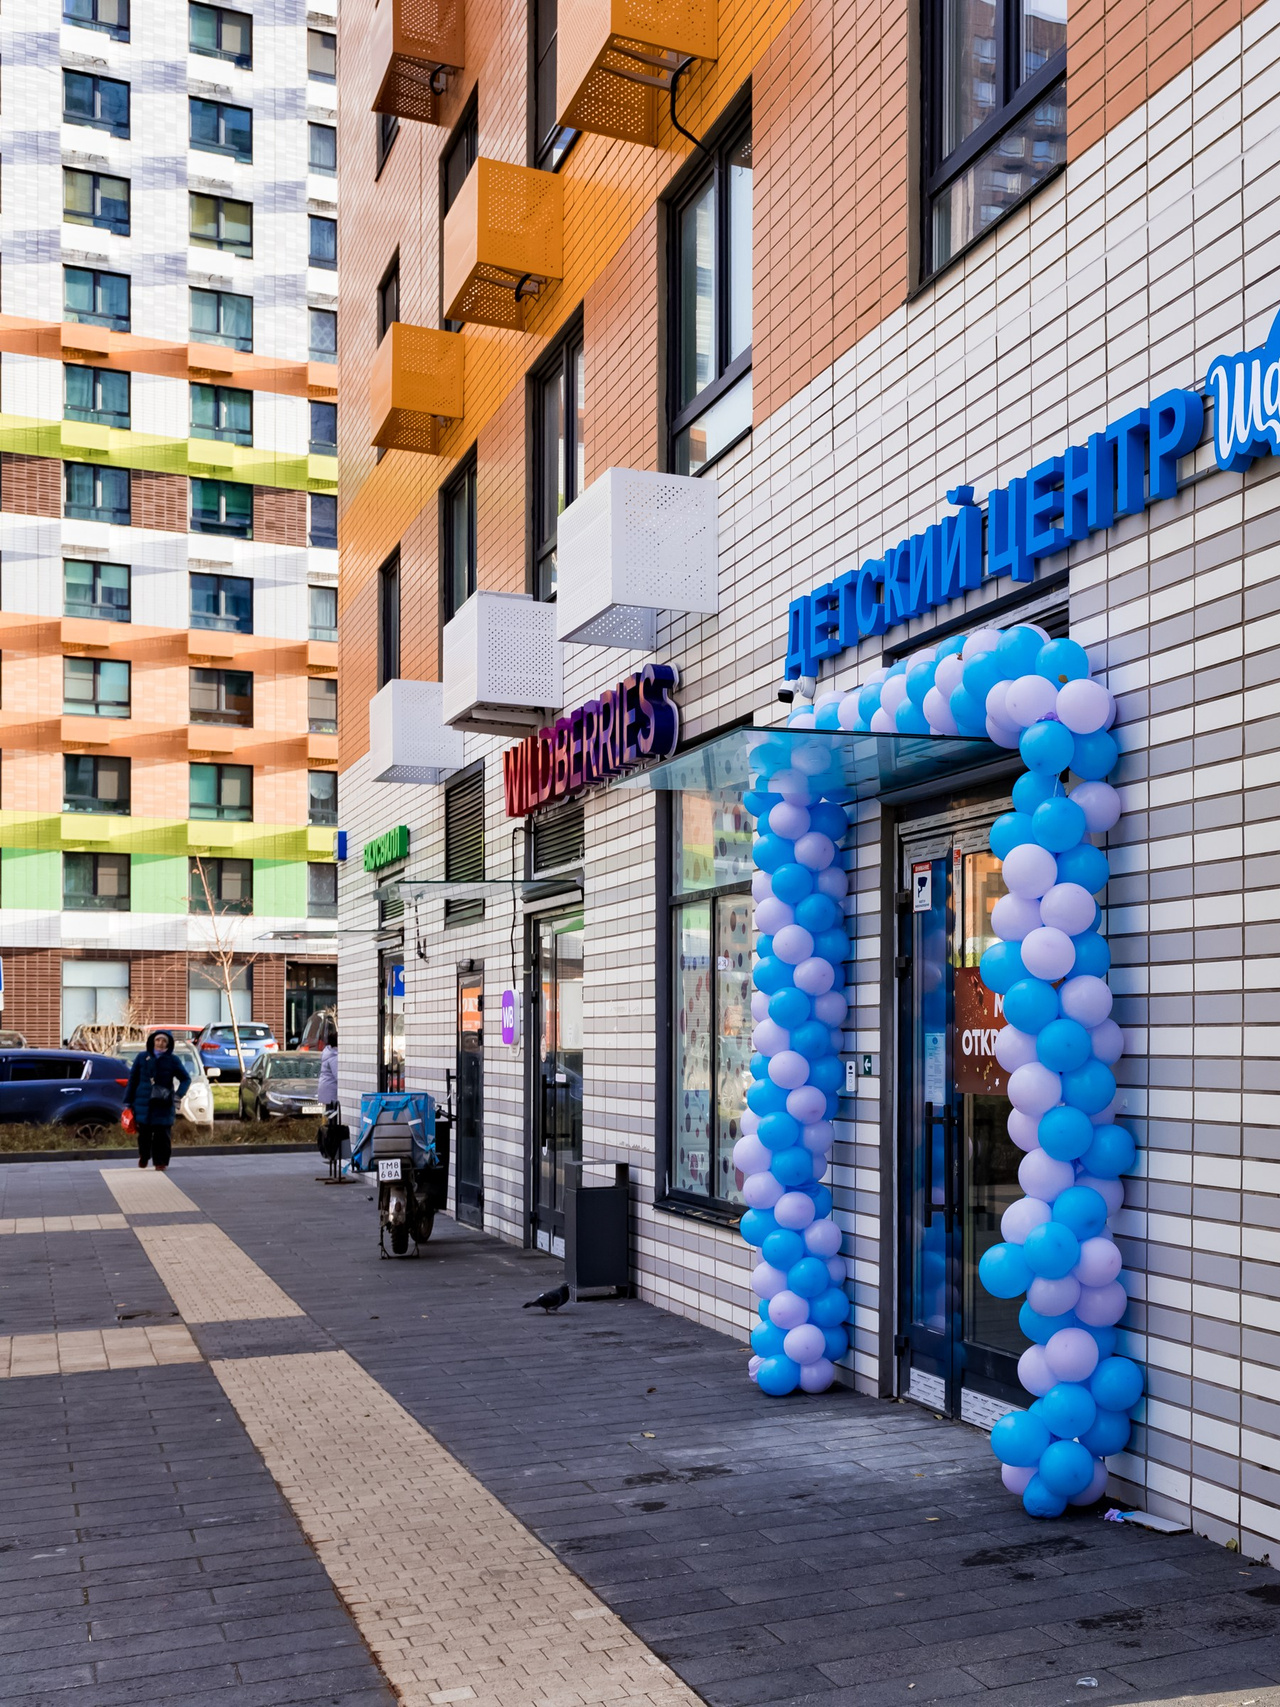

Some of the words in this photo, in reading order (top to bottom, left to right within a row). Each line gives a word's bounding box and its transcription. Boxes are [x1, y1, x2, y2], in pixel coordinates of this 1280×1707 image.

[785, 485, 982, 681] ДЕТСКИЙ
[987, 388, 1204, 582] ЦЕНТР
[502, 662, 679, 818] WILDBERRIES
[502, 1005, 514, 1029] WB
